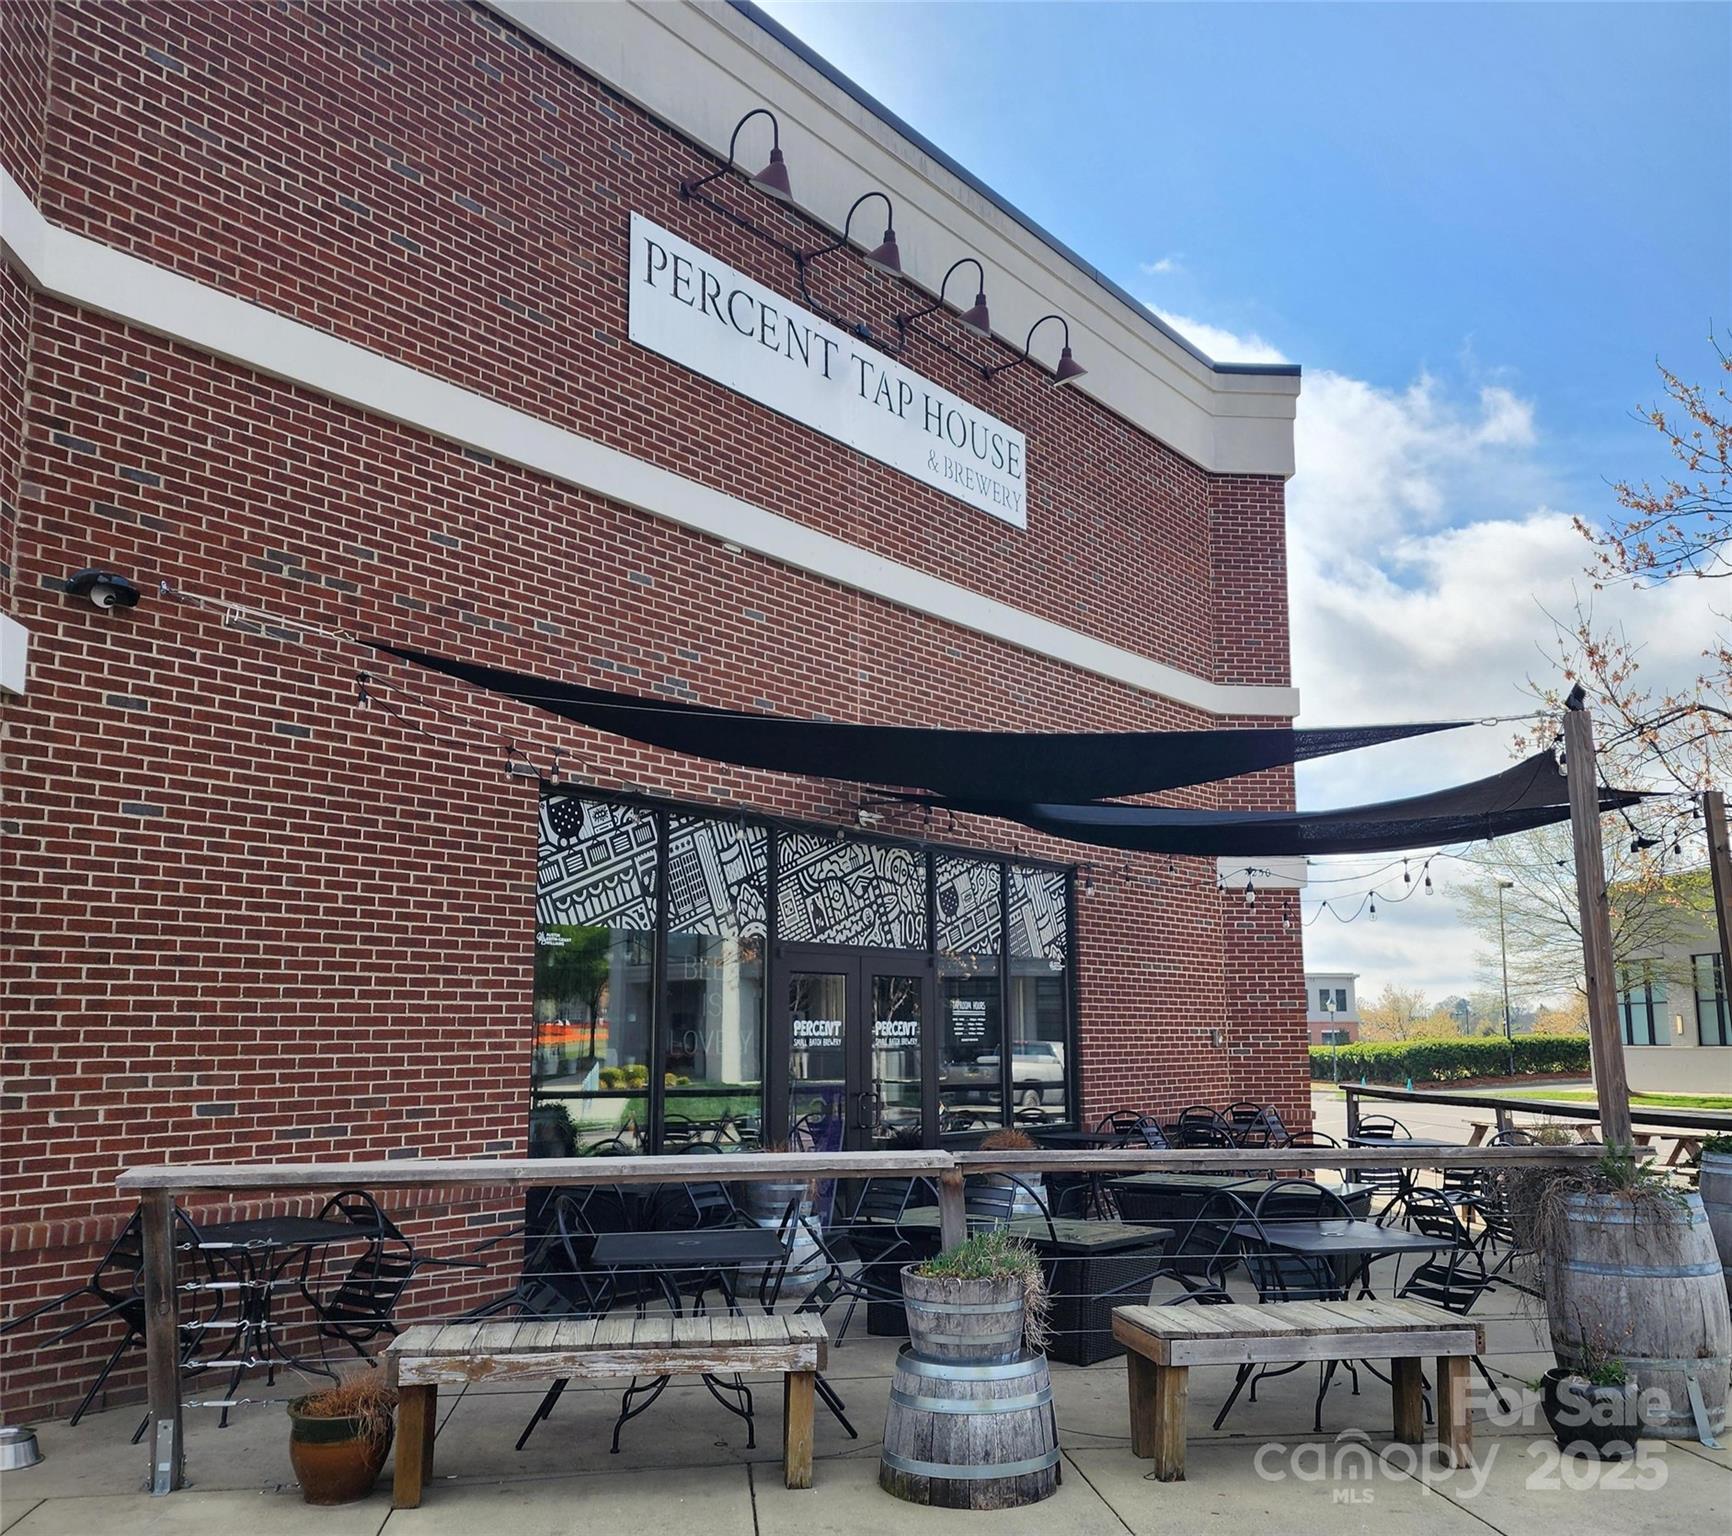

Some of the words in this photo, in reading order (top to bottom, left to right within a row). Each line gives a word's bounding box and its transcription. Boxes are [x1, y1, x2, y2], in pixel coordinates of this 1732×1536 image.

[643, 236, 839, 380] PERCENT
[851, 353, 913, 419] TAP
[922, 393, 1022, 480] HOUSE
[927, 448, 939, 473] &
[943, 455, 1022, 513] BREWERY
[684, 954, 727, 980] BEE
[702, 992, 723, 1017] IS
[793, 1020, 842, 1037] PERCENT
[874, 1020, 918, 1037] PERCENT
[670, 1029, 753, 1056] LOVEY
[808, 1038, 822, 1047] BATCH
[823, 1037, 842, 1047] BREWERY
